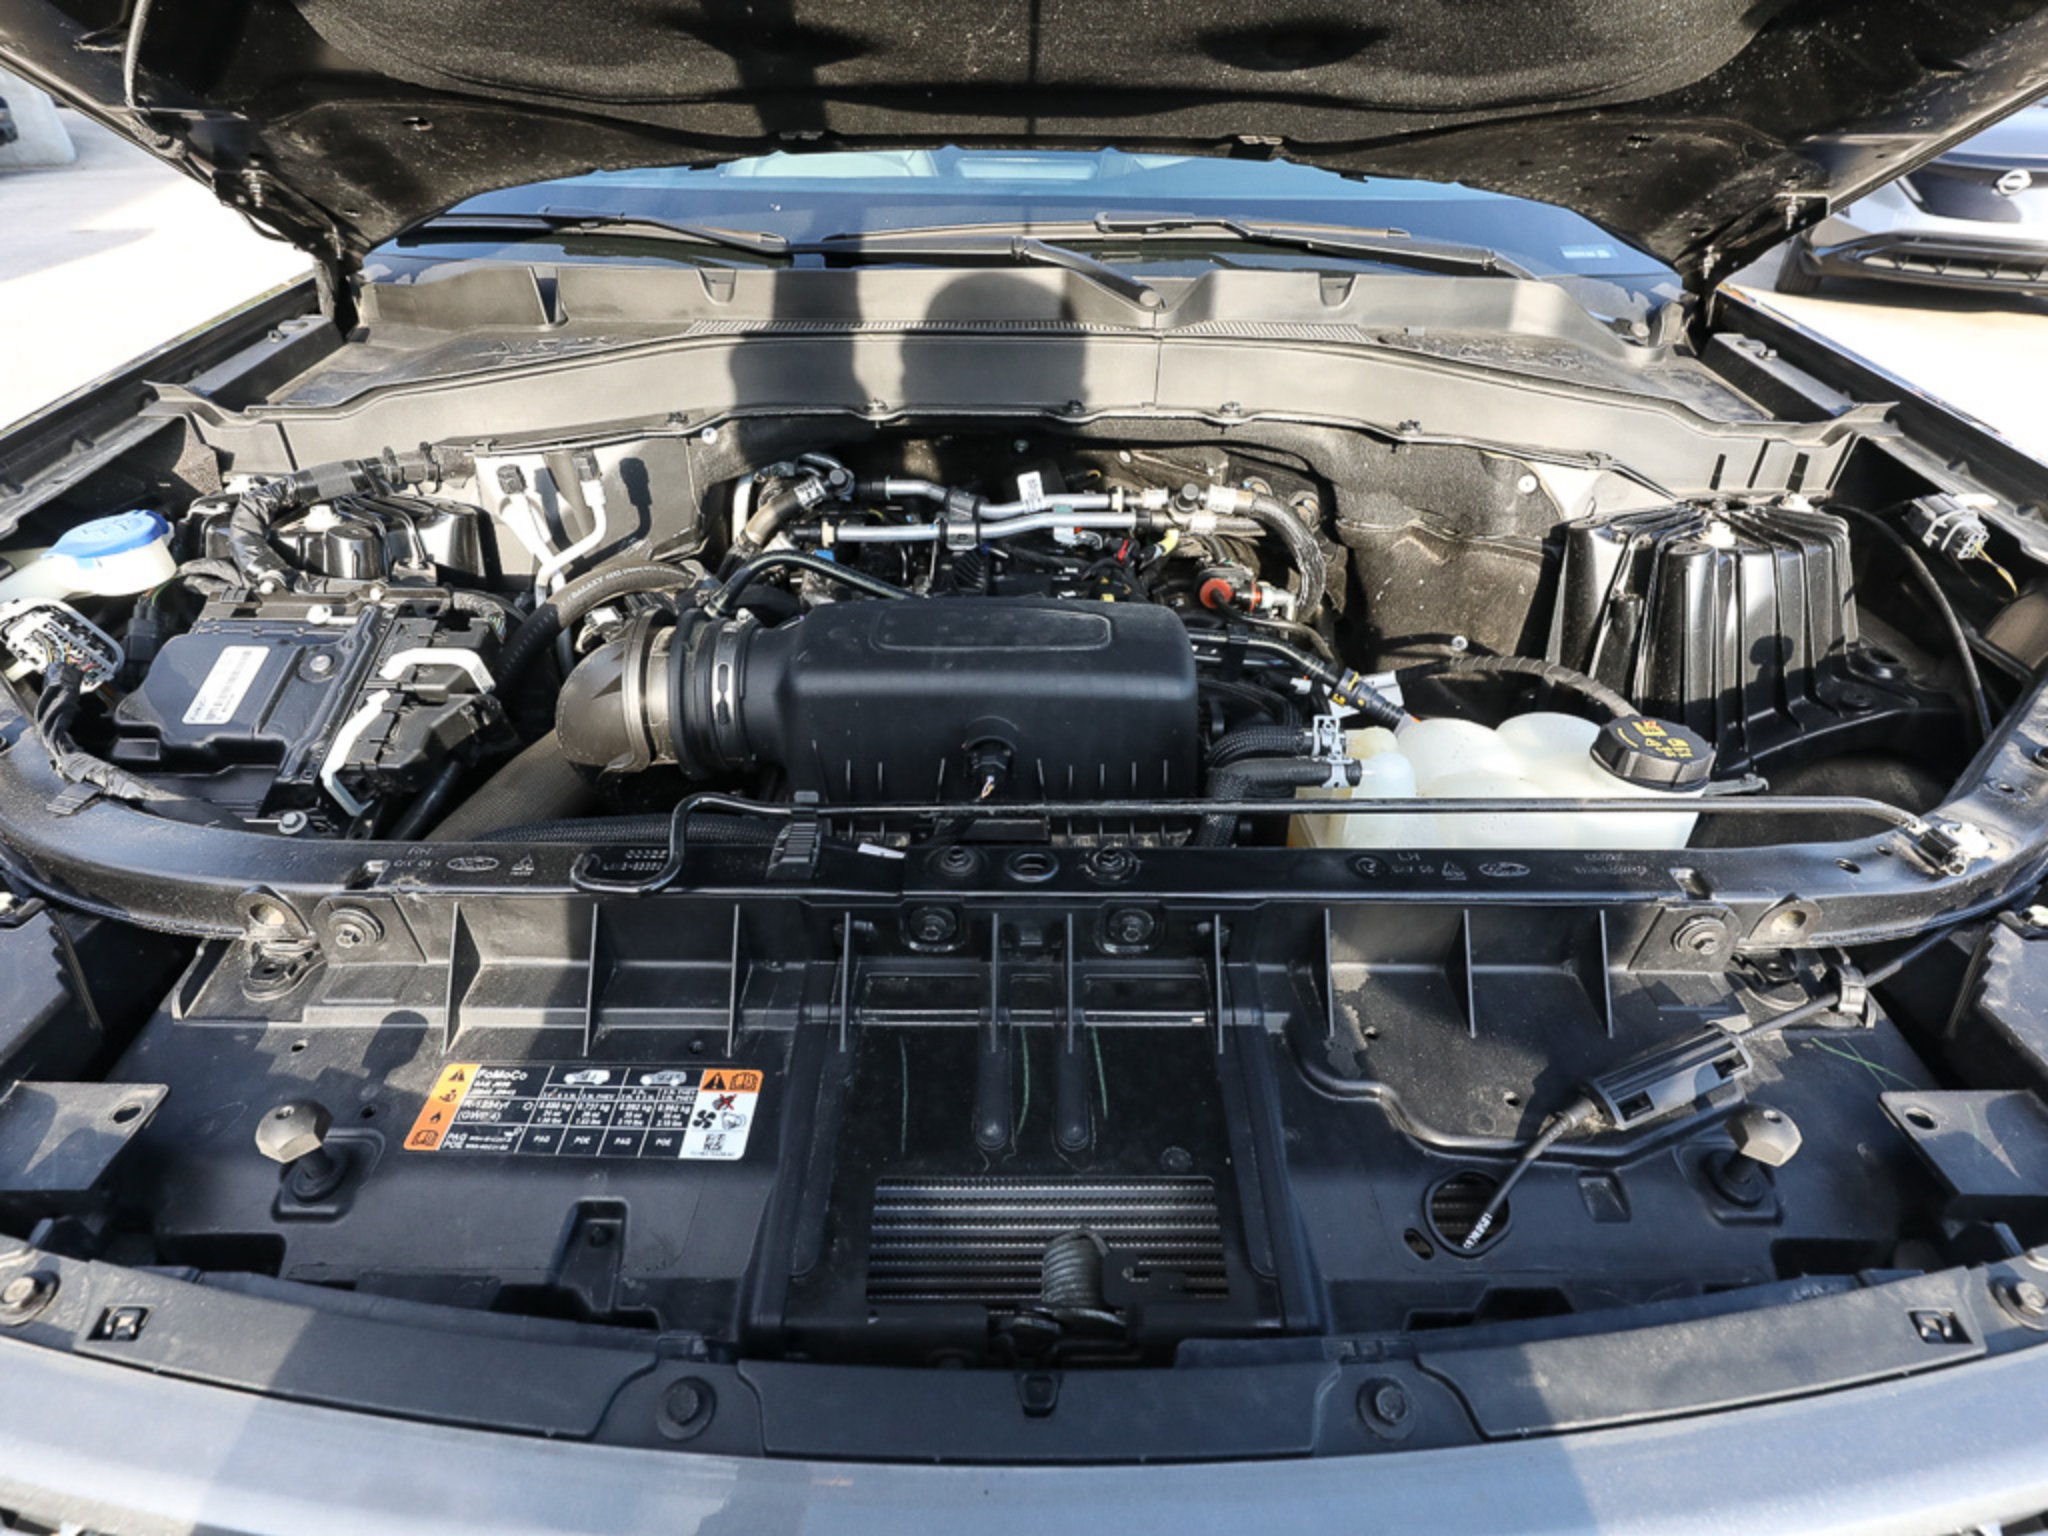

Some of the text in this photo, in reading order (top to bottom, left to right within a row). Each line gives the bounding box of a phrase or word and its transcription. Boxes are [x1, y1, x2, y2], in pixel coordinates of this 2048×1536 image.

[477, 1068, 529, 1081] FoMoCo
[462, 1099, 511, 1111] R-1234yf
[533, 1135, 551, 1143] PAG
[573, 1136, 591, 1144] POE
[613, 1137, 631, 1145] PAG
[655, 1138, 672, 1146] POE
